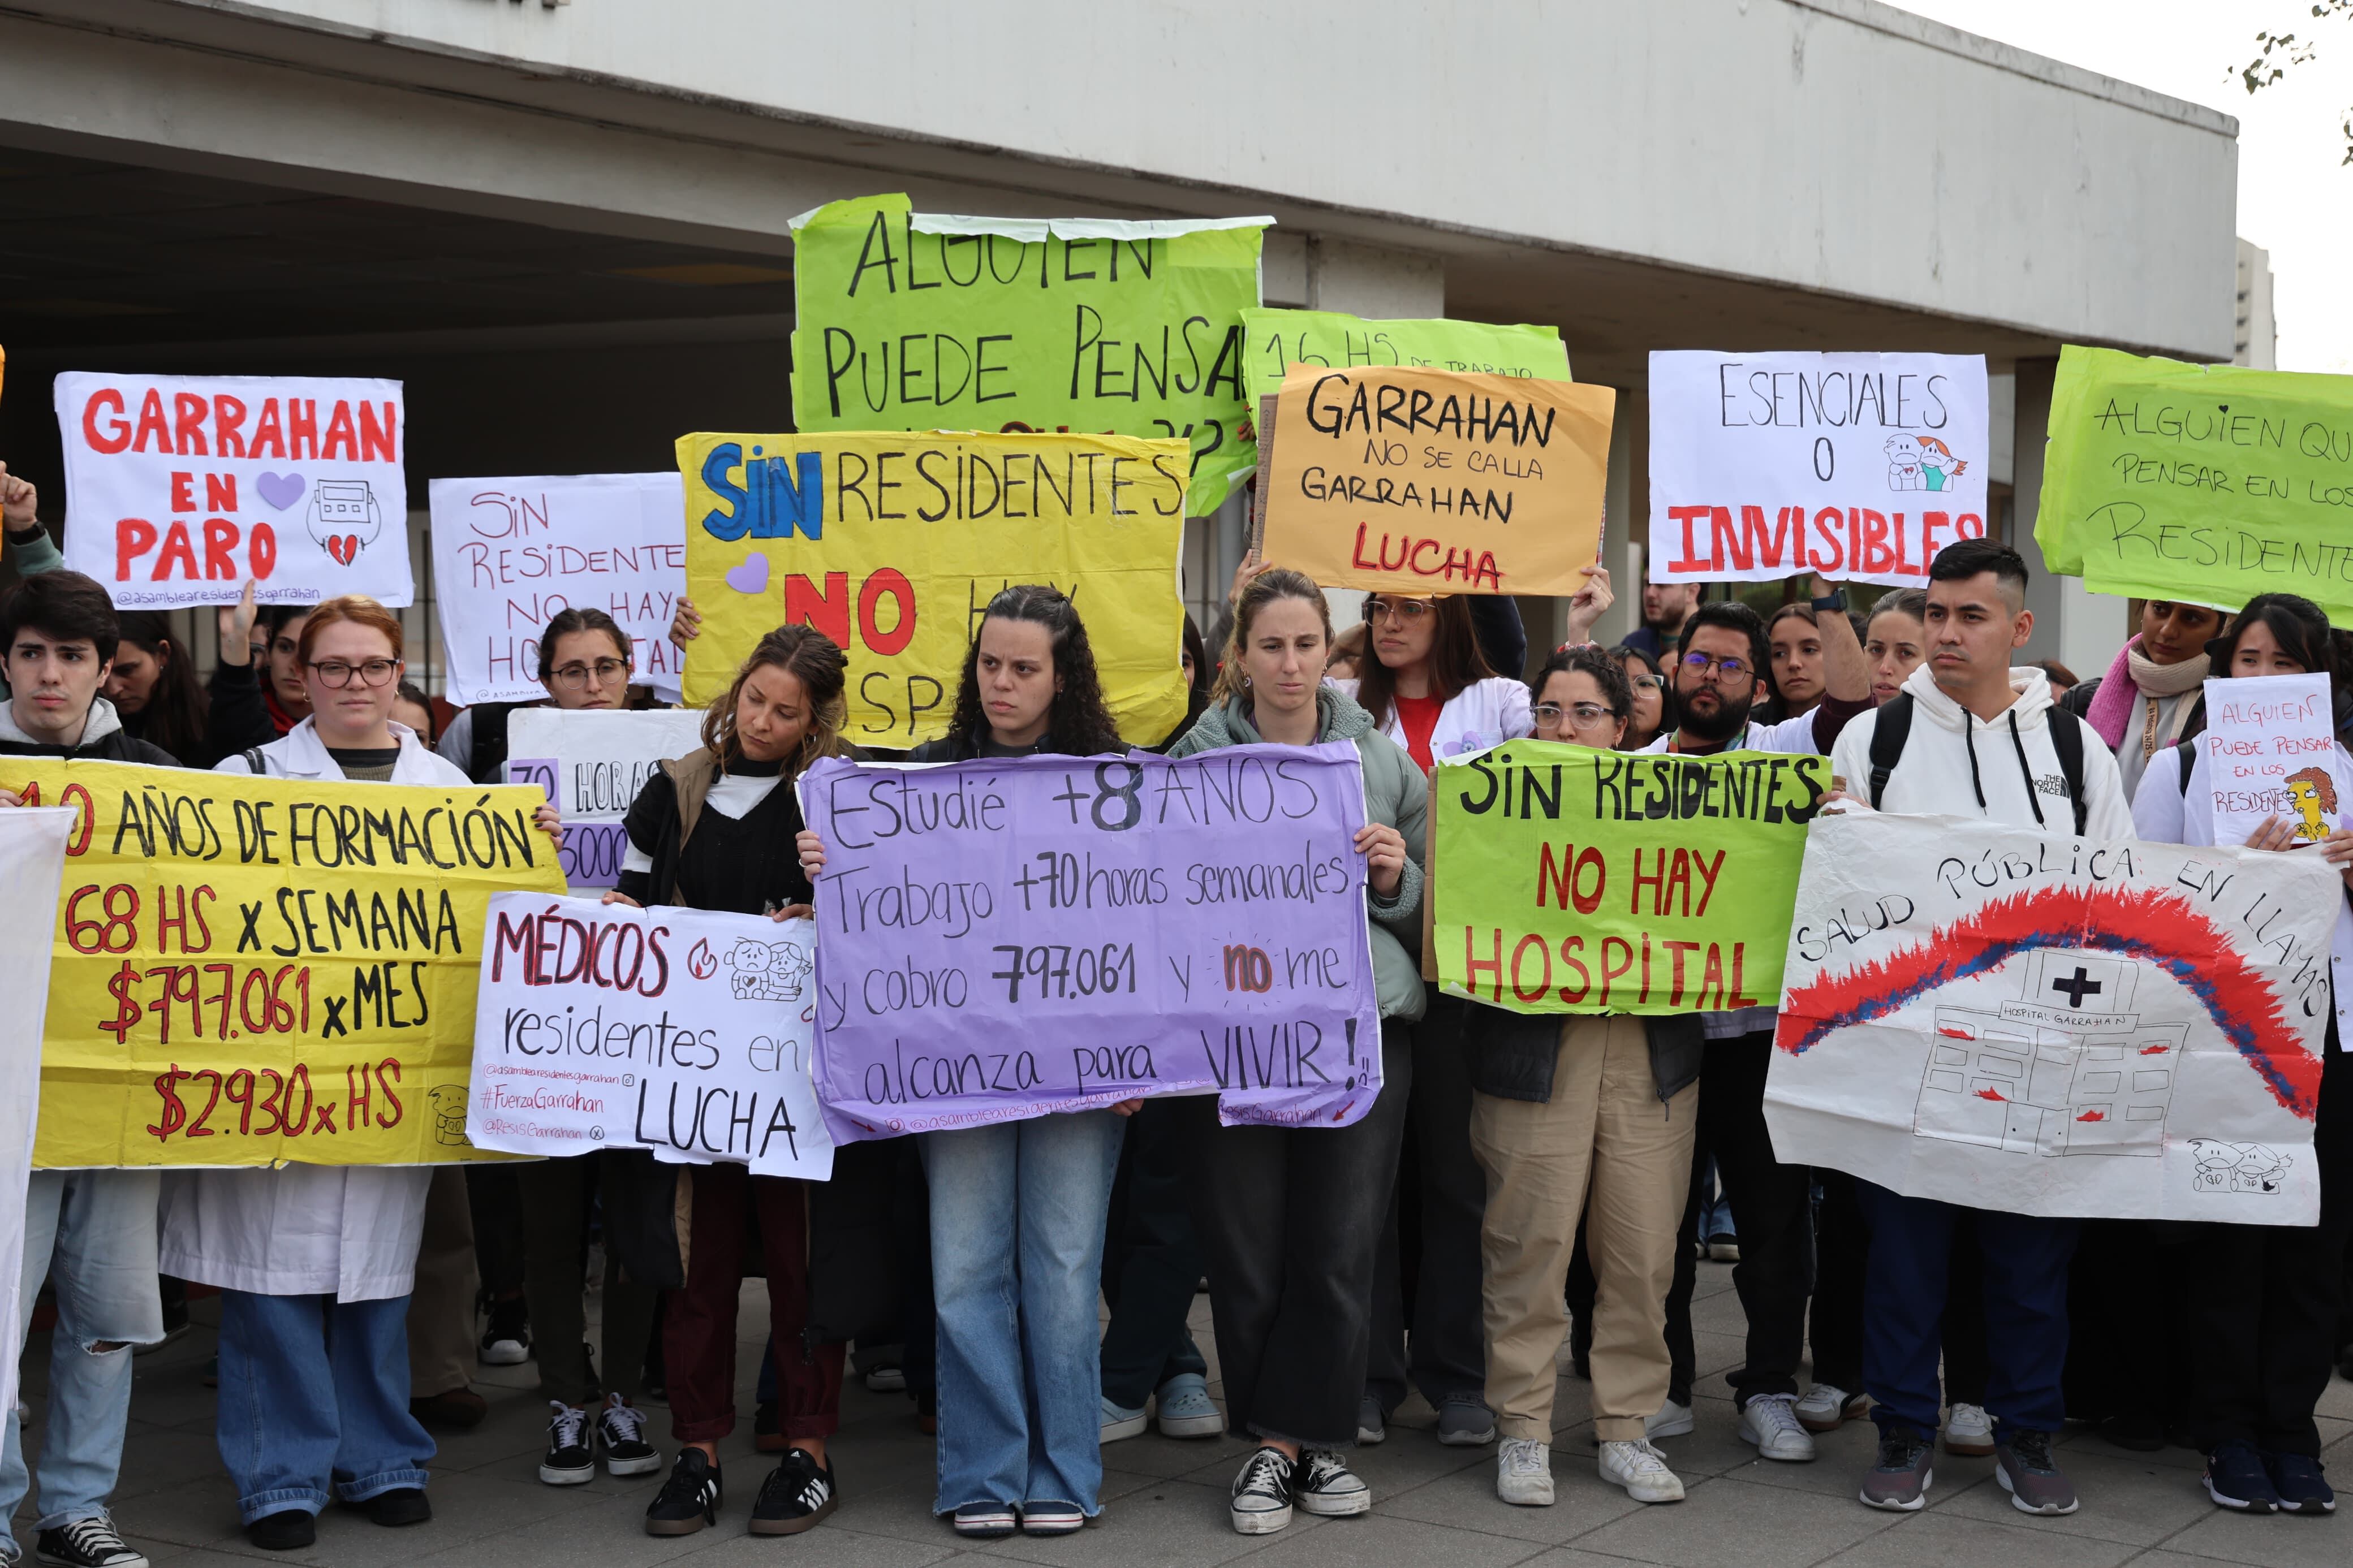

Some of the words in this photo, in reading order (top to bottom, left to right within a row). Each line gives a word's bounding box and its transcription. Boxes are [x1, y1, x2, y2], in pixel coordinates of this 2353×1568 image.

[847, 211, 1152, 297] ALGUIEN
[824, 327, 1016, 417] PUEDE
[1070, 305, 1246, 402] PENSA
[1266, 332, 1329, 377] 16
[1346, 331, 1398, 367] HS
[83, 388, 395, 463] GARRAHAN
[1306, 373, 1555, 448] GARRAHAN
[1720, 363, 1947, 429] ESENCIALES
[171, 472, 238, 512] EN
[1363, 439, 1407, 468] NO
[1423, 446, 1453, 468] SE
[1467, 451, 1543, 481] CALLA
[1813, 437, 1834, 482] O
[2112, 453, 2234, 493] PENSAR
[2245, 476, 2289, 499] EN
[1300, 466, 1512, 524] GARRAHAN
[116, 518, 276, 582] PARO
[458, 542, 685, 590] RESiDENTE
[1352, 521, 1509, 595] LUCHA
[117, 588, 320, 606] @asamblearesidenesgarrahan
[508, 593, 568, 629] NO
[610, 592, 673, 622] HAY
[785, 567, 916, 656] NO
[489, 636, 682, 683] HOTAL
[2222, 694, 2317, 727] ALGUIEN
[2209, 737, 2263, 757] PUEDE
[2272, 736, 2333, 754] PENSAR
[2233, 766, 2253, 777] EN
[2262, 764, 2285, 776] LOS
[576, 761, 660, 812] HORA
[830, 774, 1006, 850] Estudié
[1052, 761, 1144, 831] +8
[1594, 755, 1824, 824] RESIDENTES
[2032, 779, 2060, 788] NORTH
[2039, 787, 2059, 796] FACE
[113, 785, 223, 861] AÑOS
[233, 800, 279, 864] DE
[821, 864, 993, 939] Trabajo
[1013, 851, 1079, 912] +70
[1086, 852, 1168, 910] horas
[1186, 840, 1348, 906] semanales
[1536, 841, 1605, 914] NO
[1631, 848, 1726, 917] HAY
[66, 883, 139, 954] 68
[159, 883, 217, 954] HS
[272, 887, 462, 957] SEMANA
[492, 904, 670, 998] MÉDICOS
[1796, 894, 1915, 961] SALUD
[2177, 859, 2235, 903] EN
[2243, 892, 2327, 1017] LLAMAS
[98, 960, 310, 1045] $797.061
[824, 978, 849, 1033] y
[864, 954, 968, 1010] cobro
[992, 942, 1136, 1004] 797.061
[1223, 943, 1272, 994] no
[1285, 939, 1347, 991] me
[505, 1005, 719, 1070] residentes
[748, 1035, 798, 1072] en
[2054, 1015, 2126, 1027] GARRAHAN
[480, 1083, 604, 1113] #FuerzaGarrahan
[864, 1039, 1042, 1107] alcanza
[1075, 1043, 1157, 1096] para
[635, 1078, 798, 1160] LUCHA
